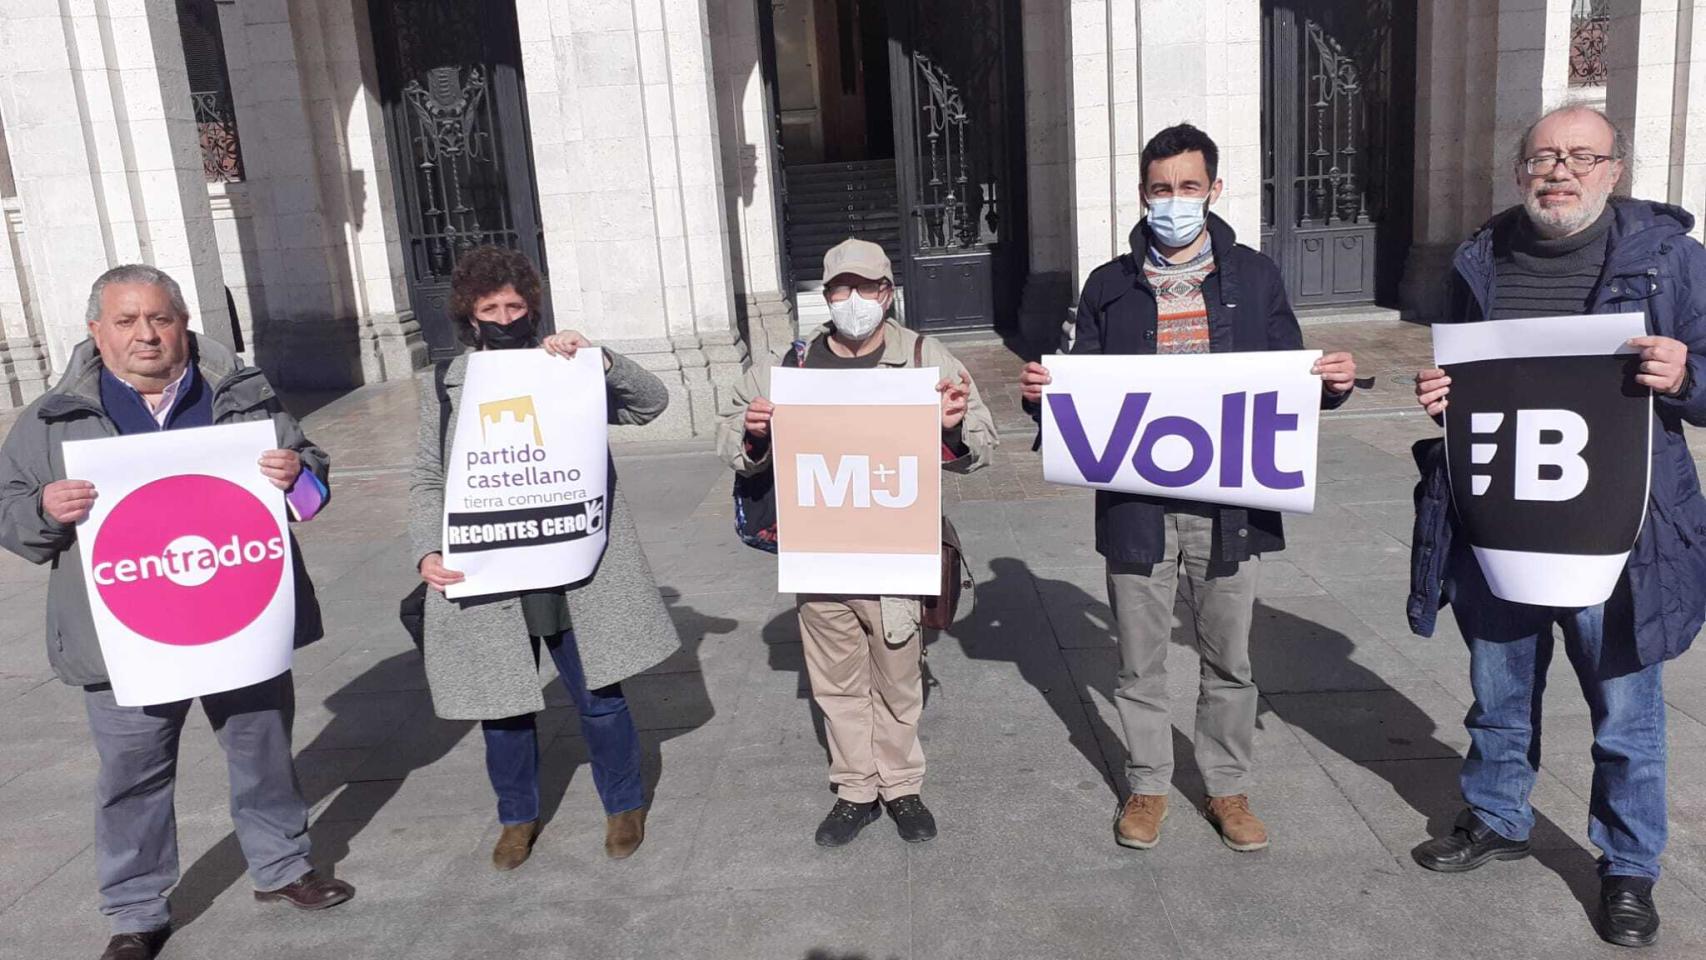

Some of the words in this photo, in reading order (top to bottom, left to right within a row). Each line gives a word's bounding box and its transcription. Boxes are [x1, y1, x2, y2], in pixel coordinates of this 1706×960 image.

[1046, 390, 1306, 489] Volt
[466, 444, 546, 471] partido
[466, 467, 581, 488] castellano
[464, 494, 503, 509] tierra
[508, 490, 588, 507] comunera
[449, 520, 540, 545] RECORTES
[543, 515, 587, 537] CERO
[94, 534, 284, 585] centrados
